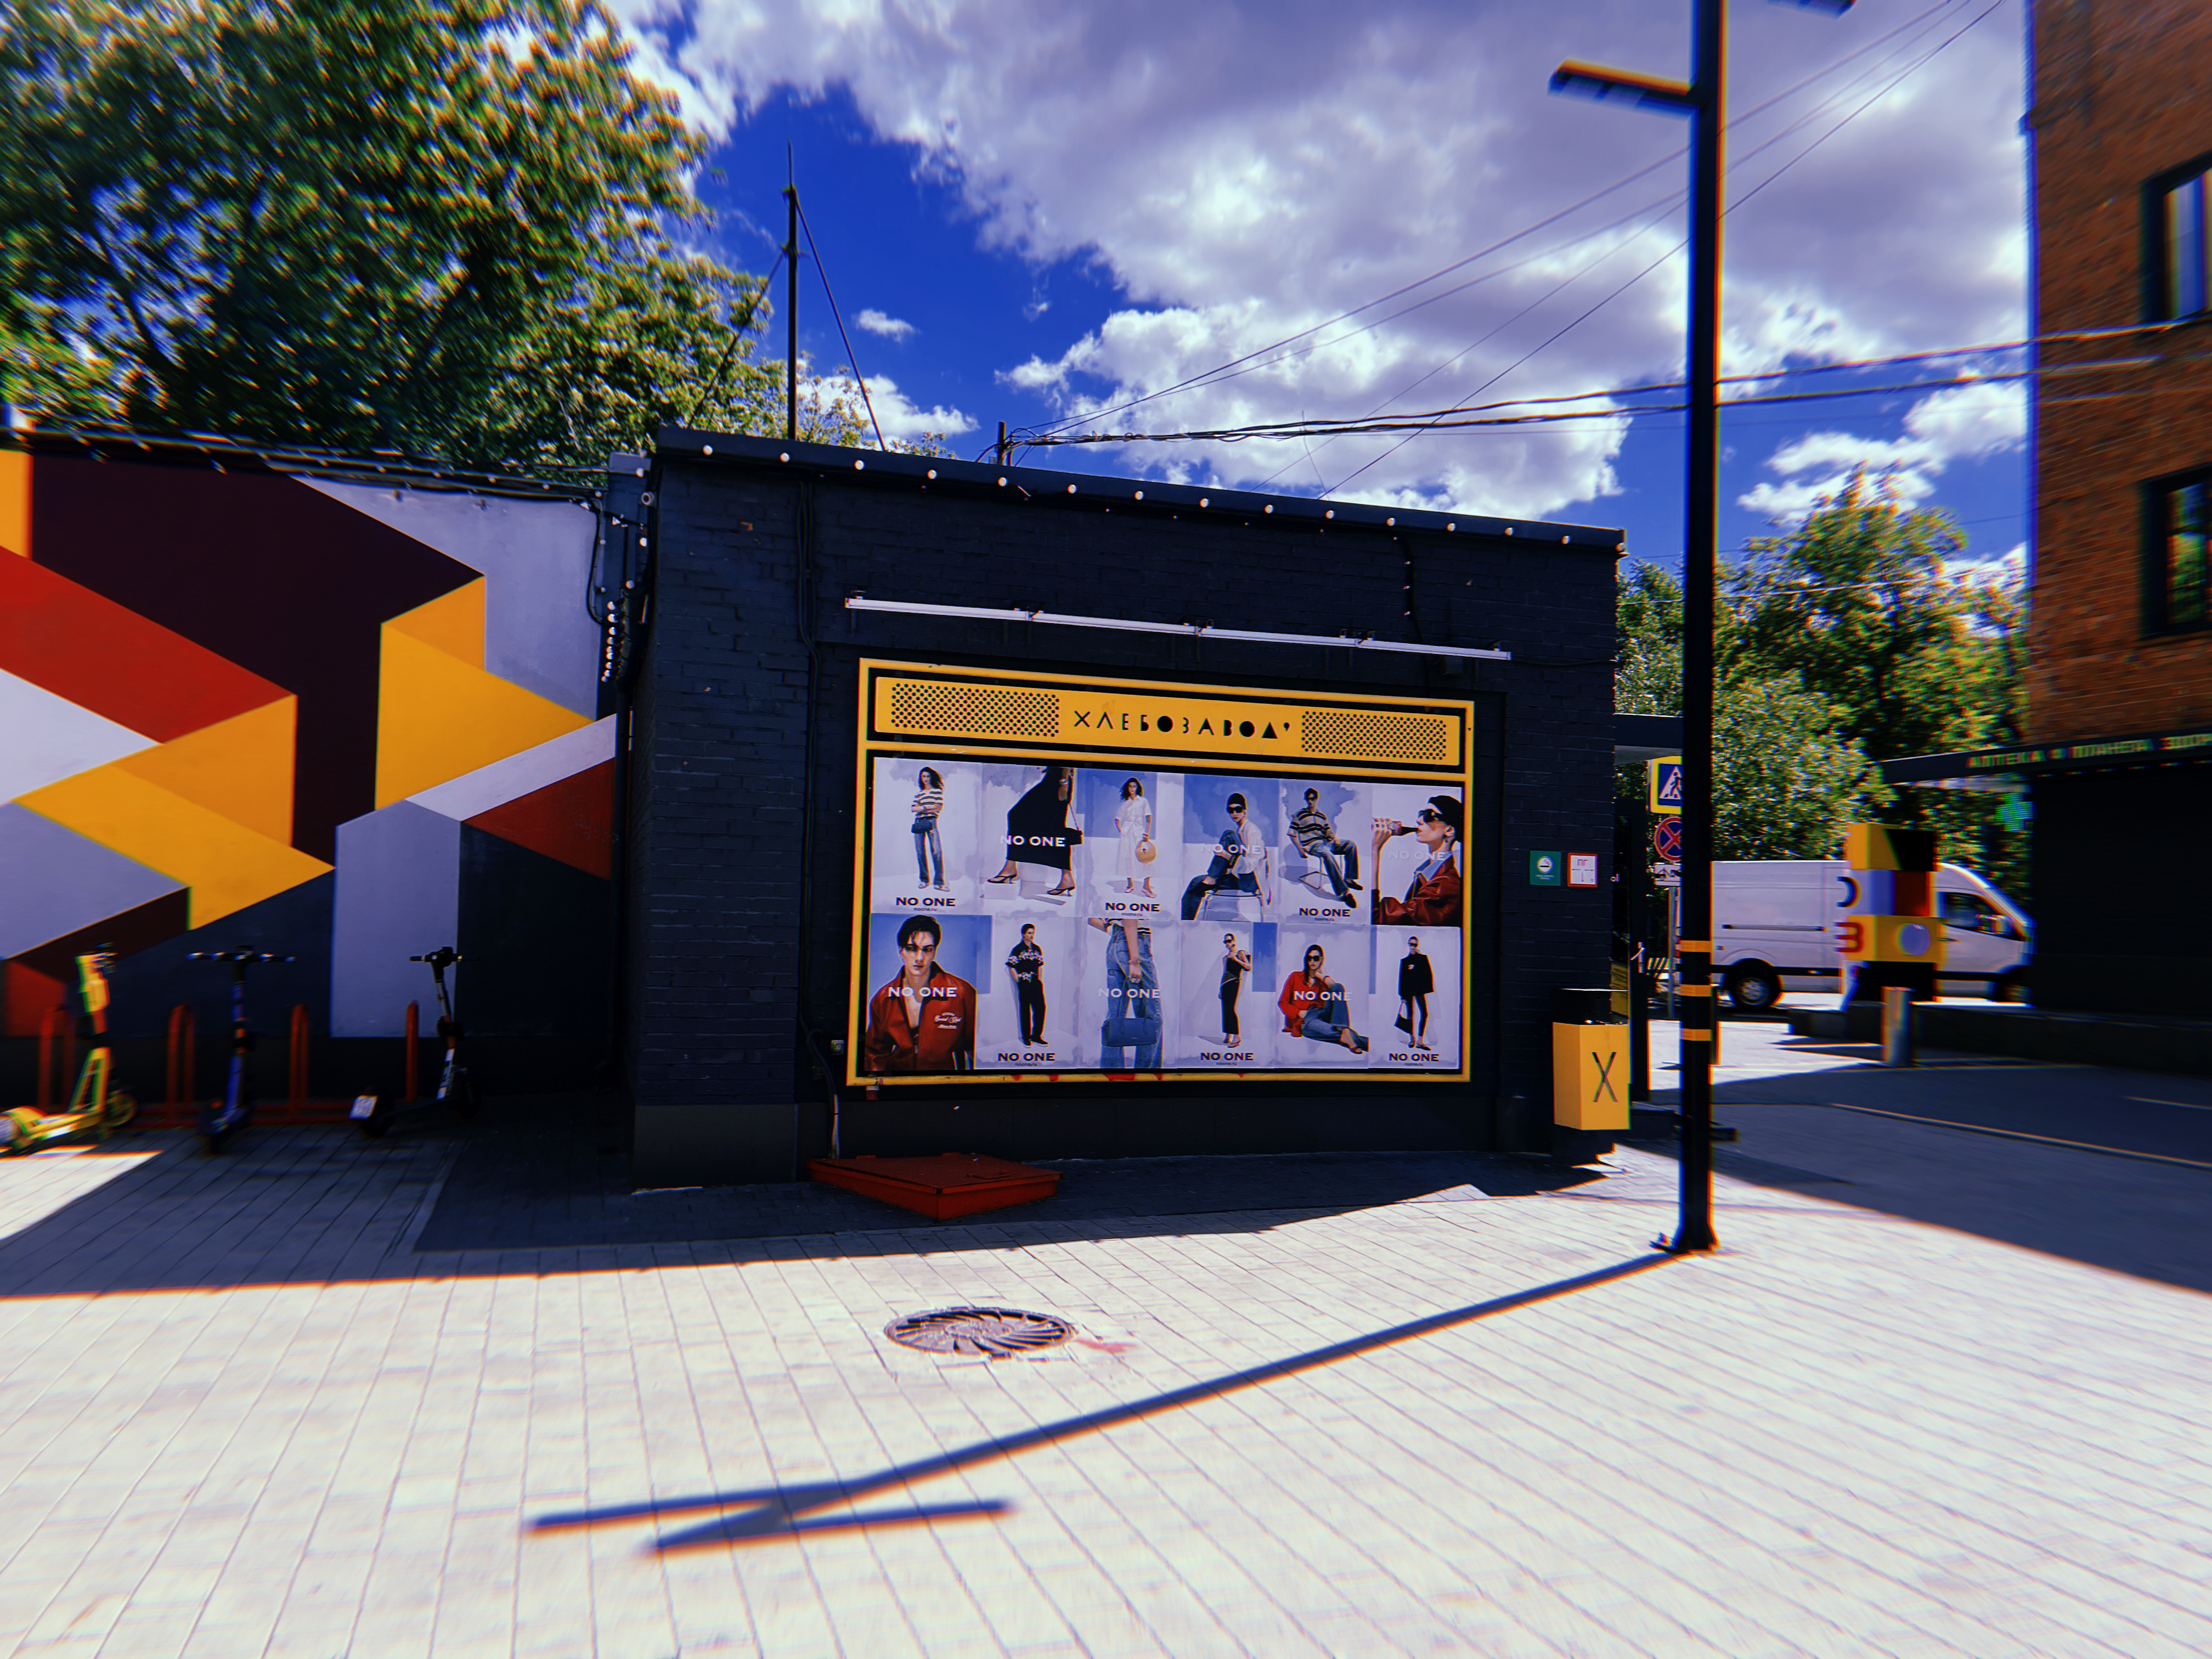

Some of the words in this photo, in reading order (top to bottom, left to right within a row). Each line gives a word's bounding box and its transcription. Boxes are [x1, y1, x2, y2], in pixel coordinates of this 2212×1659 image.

[1000, 836, 1025, 845] NO
[1029, 837, 1066, 847] ONE
[1199, 844, 1223, 854] NO
[1227, 844, 1261, 854] ONE
[1388, 850, 1410, 860] NO
[1414, 851, 1445, 861] ONE
[895, 897, 921, 906] NO
[923, 898, 957, 907] ONE
[1105, 902, 1129, 911] NO
[1129, 903, 1160, 912] ONE
[1299, 908, 1321, 917] NO
[1322, 909, 1351, 917] ONE
[888, 987, 915, 998] NO
[918, 987, 958, 998] ONE
[1098, 988, 1122, 998] NO
[1126, 989, 1161, 998] ONE
[1293, 991, 1316, 1001] NO
[1318, 991, 1352, 1001] ONE
[997, 1053, 1021, 1062] NO
[1023, 1053, 1056, 1062] ONE
[1200, 1052, 1222, 1061] NO
[1223, 1053, 1254, 1062] ONE
[1389, 1053, 1410, 1062] NO
[1411, 1054, 1440, 1062] ONE
